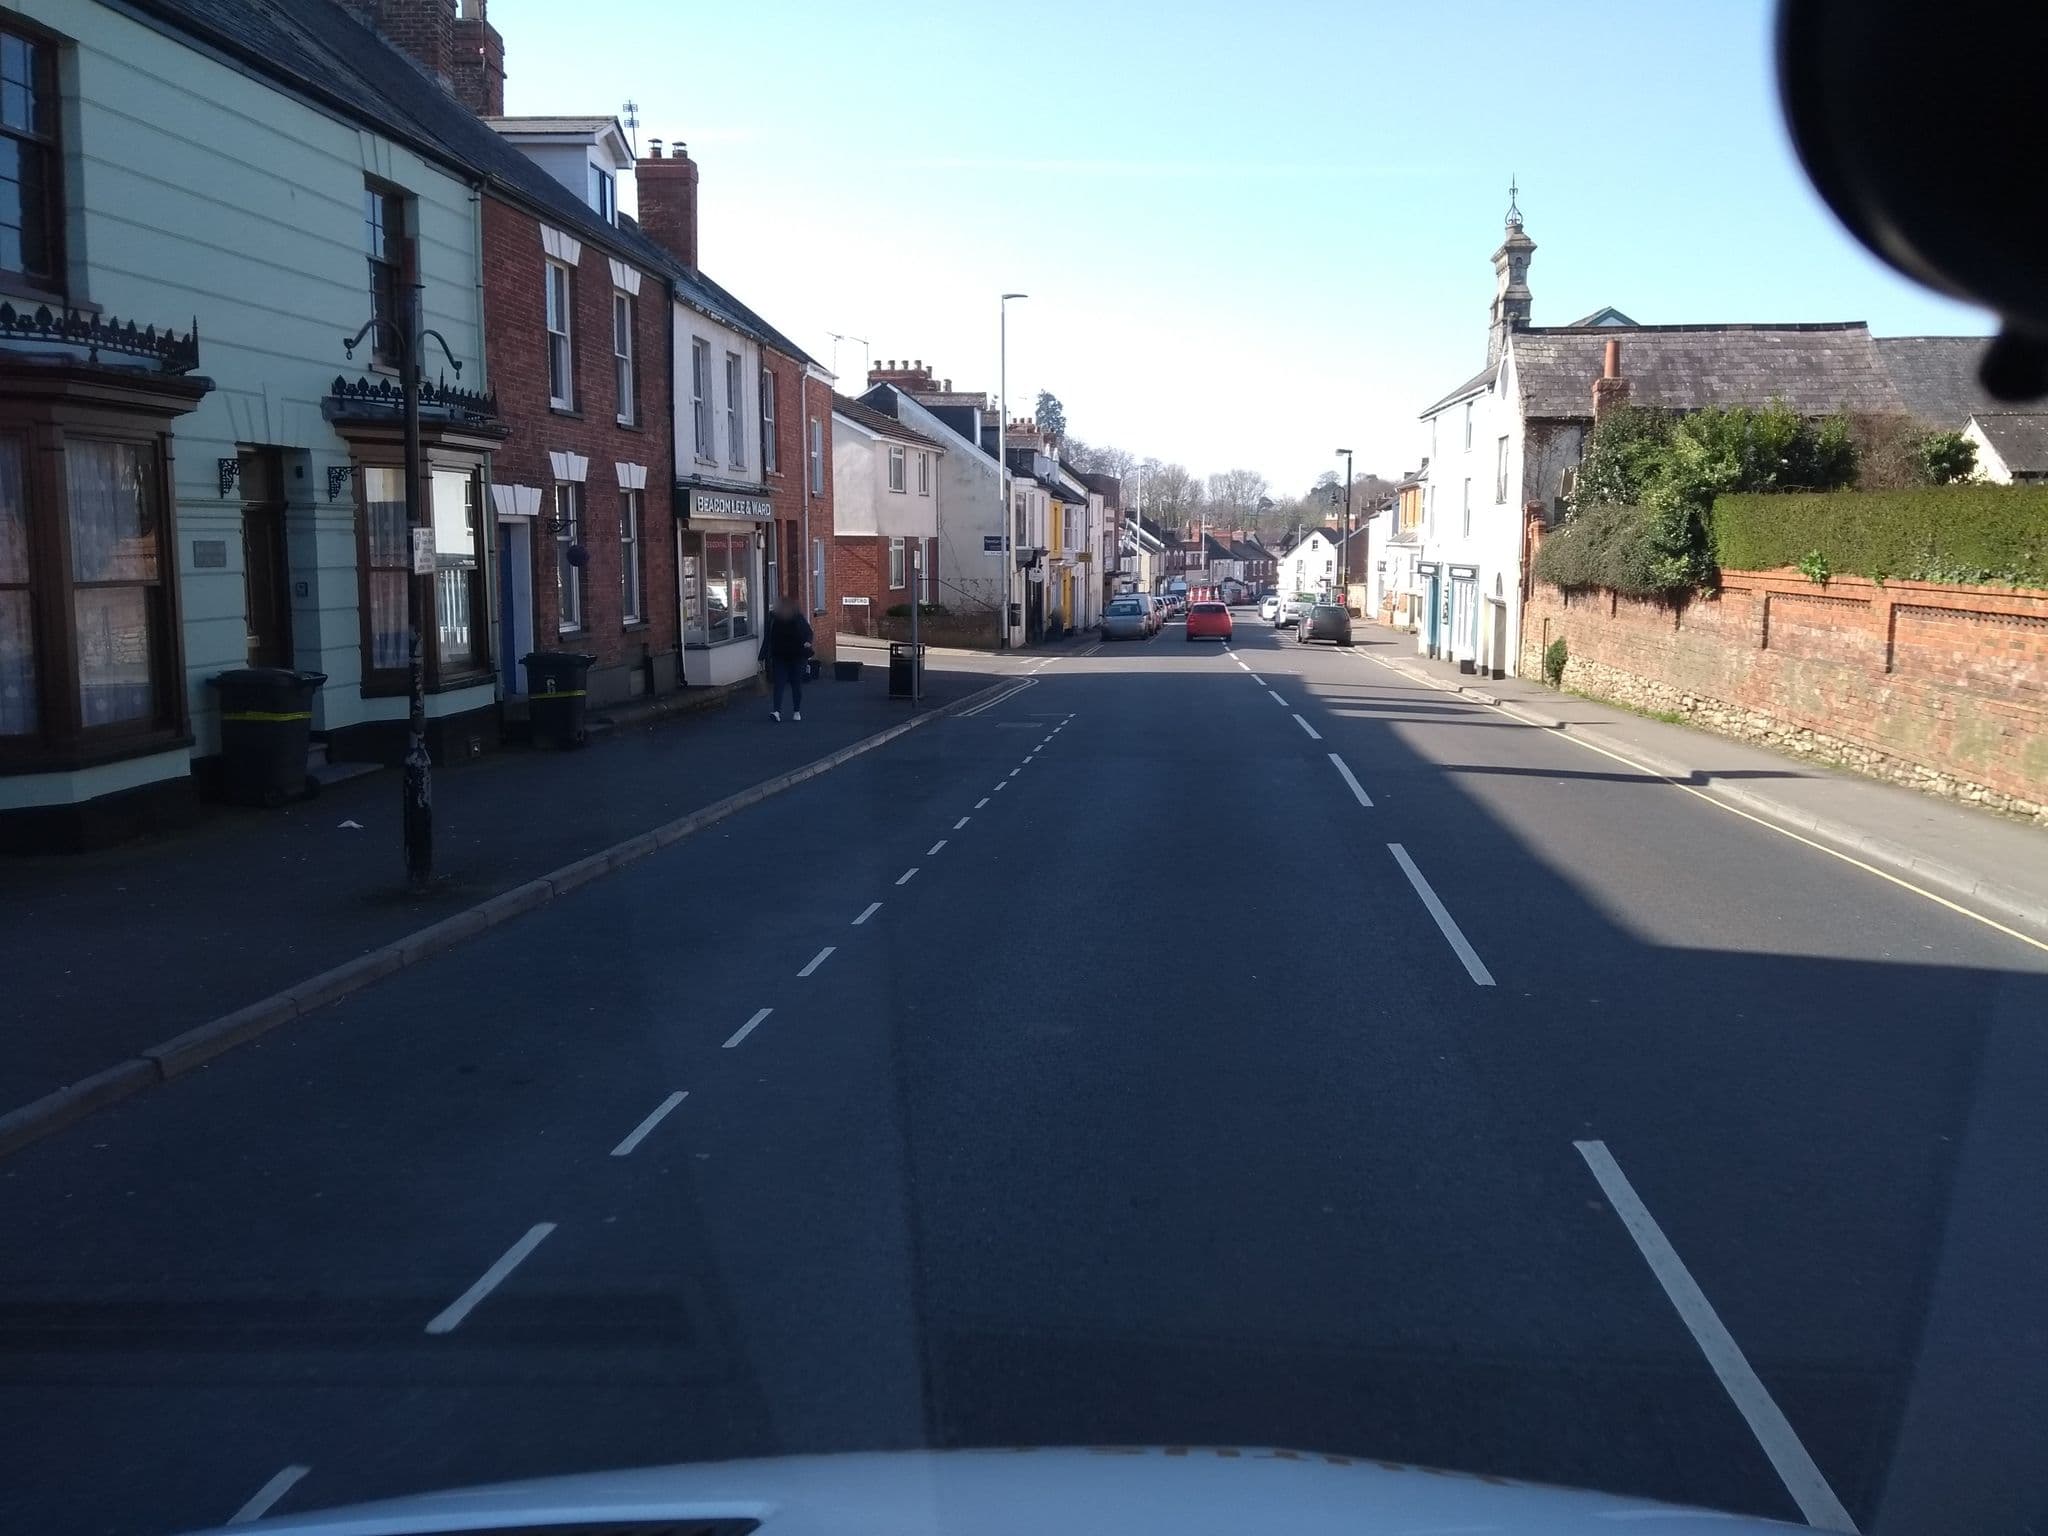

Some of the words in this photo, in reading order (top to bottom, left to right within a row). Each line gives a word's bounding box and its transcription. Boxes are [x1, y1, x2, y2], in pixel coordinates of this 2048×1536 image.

[697, 496, 731, 513] BEACON
[732, 499, 745, 514] LEE
[745, 501, 752, 515] &
[752, 501, 771, 516] WARD
